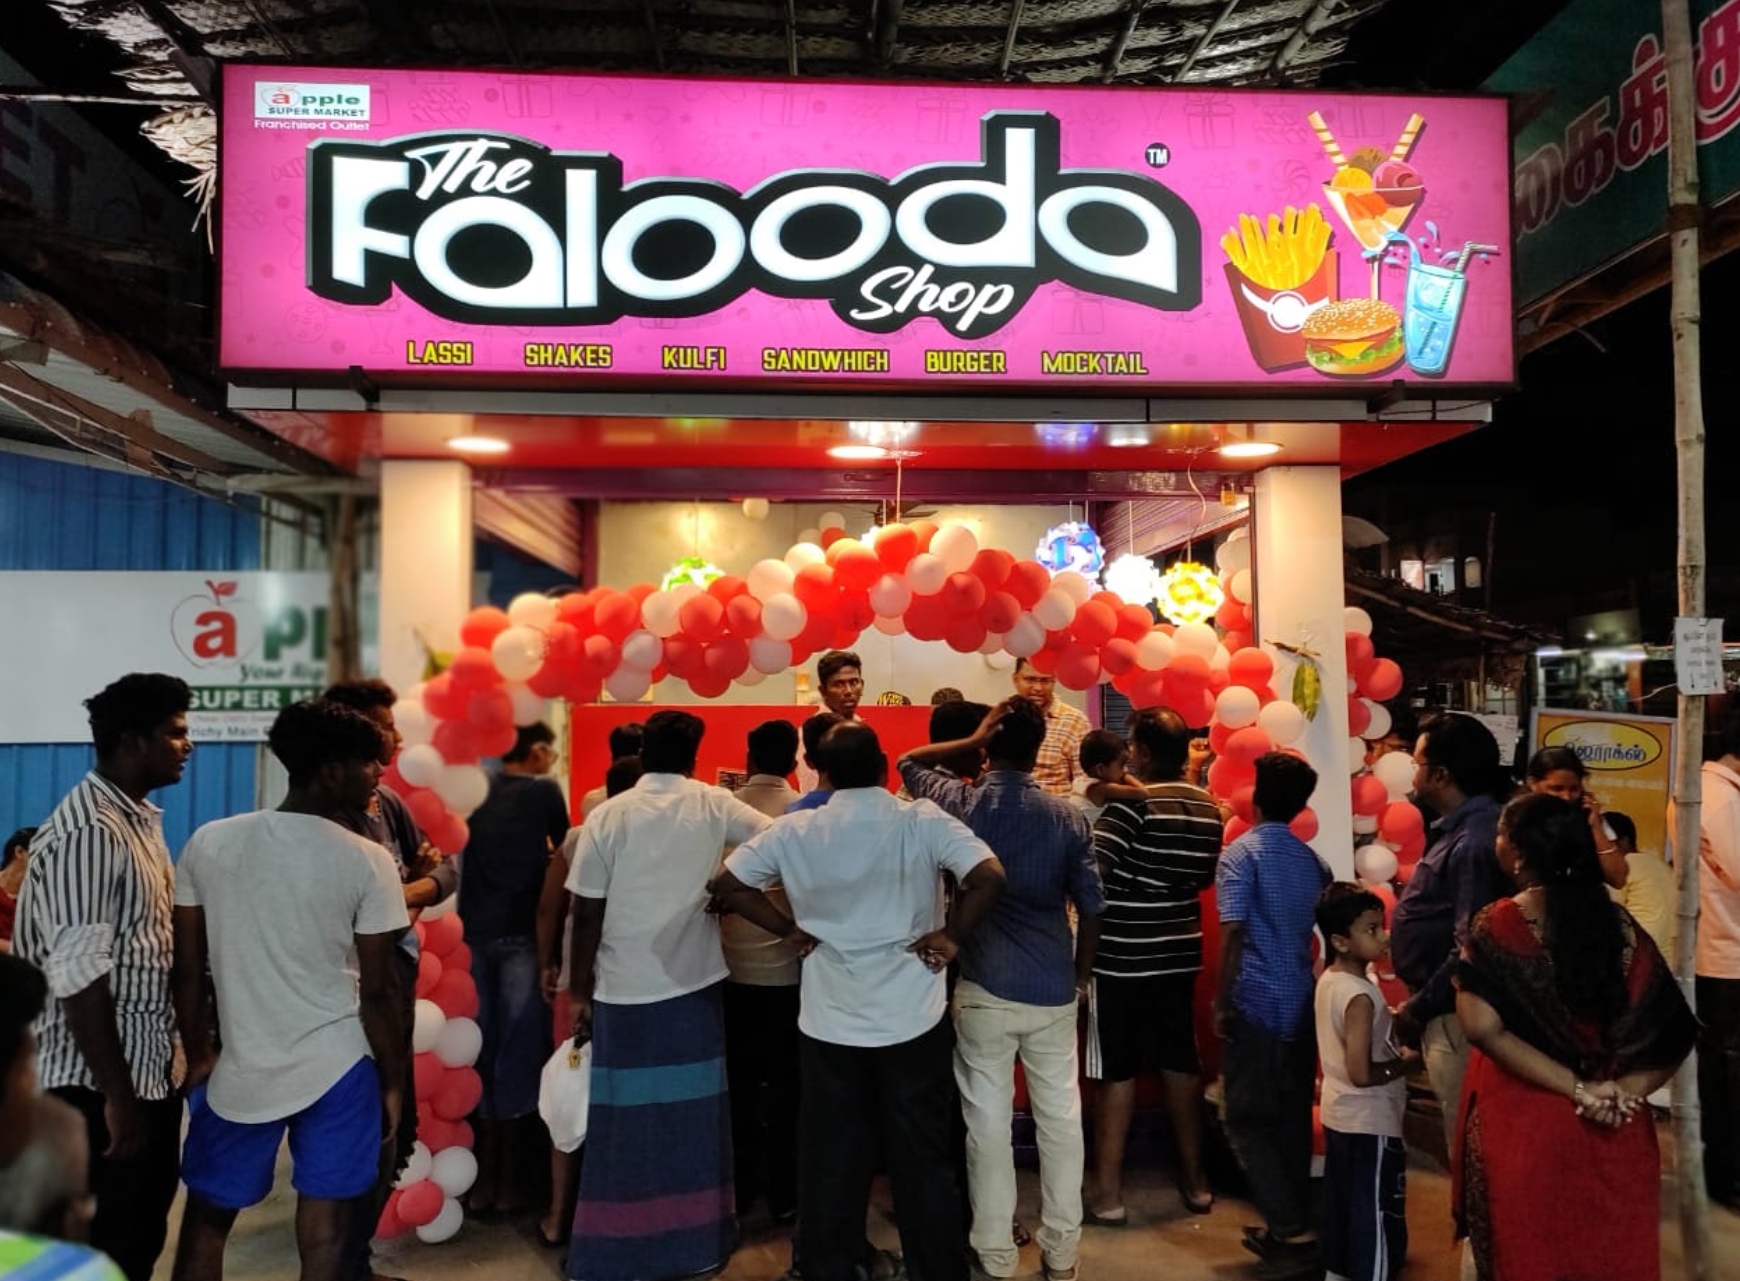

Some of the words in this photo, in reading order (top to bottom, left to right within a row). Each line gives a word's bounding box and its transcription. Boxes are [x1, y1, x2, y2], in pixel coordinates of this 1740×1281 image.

[271, 92, 361, 107] apple
[267, 106, 310, 116] SUPER
[313, 107, 367, 117] MARKET
[254, 119, 327, 130] Franchised
[329, 121, 371, 131] Outlet
[1146, 148, 1168, 165] TM
[404, 138, 533, 200] The
[331, 127, 1178, 309] Falooda
[849, 263, 1015, 332] Shop
[407, 341, 473, 364] LASSI
[524, 343, 612, 367] SHAKES
[662, 347, 726, 369] KULFI
[762, 348, 889, 372] SANDWHICH
[925, 350, 1006, 373] BURGER
[1041, 352, 1148, 374] MOCKTAIL
[188, 688, 282, 709] SUPER
